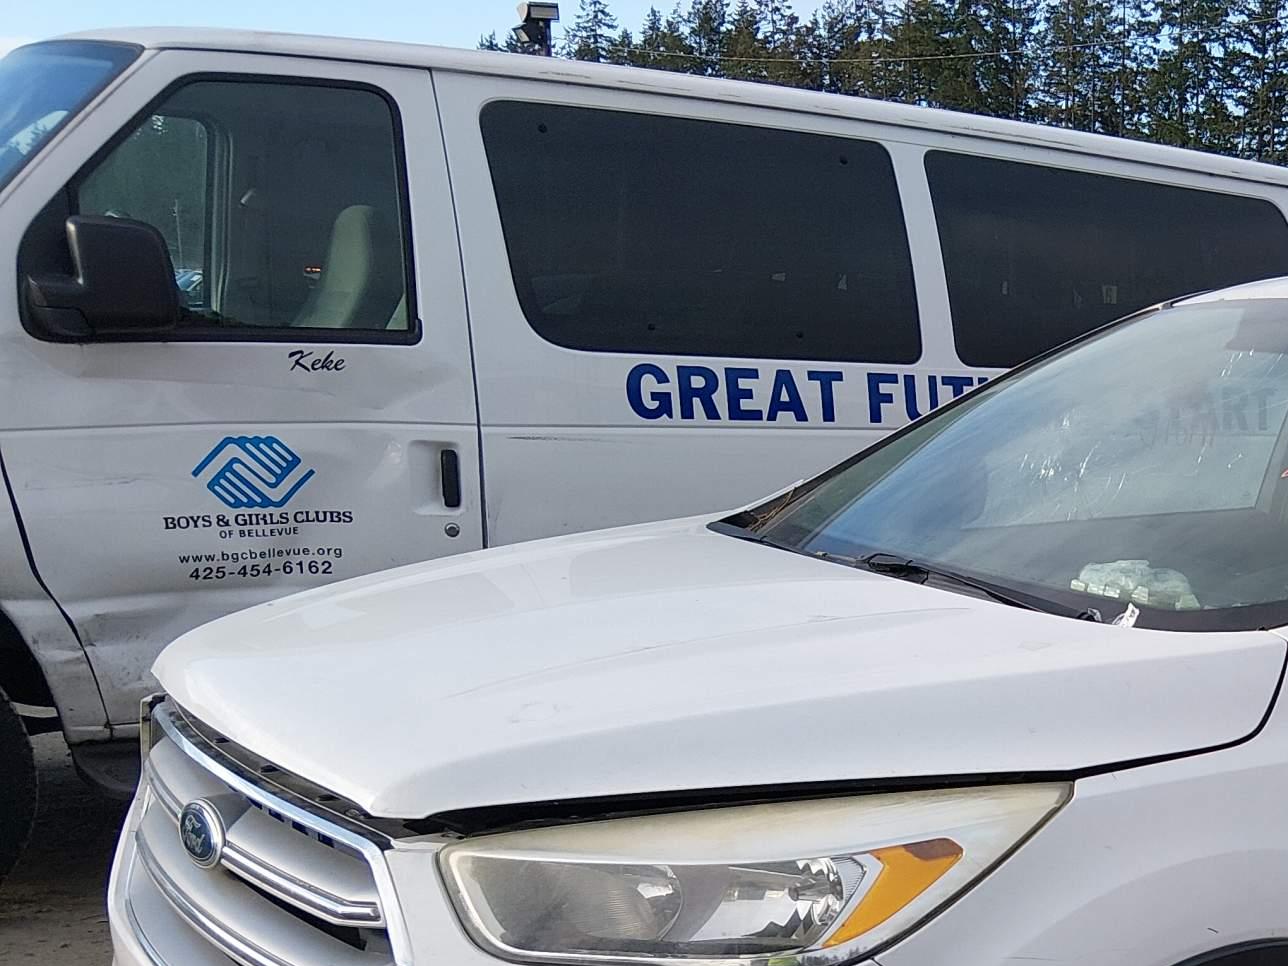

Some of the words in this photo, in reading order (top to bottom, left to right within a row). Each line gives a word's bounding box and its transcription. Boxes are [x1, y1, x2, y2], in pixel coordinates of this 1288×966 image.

[288, 350, 346, 372] Keke
[626, 363, 844, 423] GREAT
[866, 372, 989, 424] FUT
[163, 515, 212, 530] BOYS
[216, 513, 231, 528] &
[234, 512, 289, 527] GIRLS
[293, 510, 353, 525] CLUBS
[219, 530, 234, 539] OF
[239, 526, 299, 538] BELLEVUE
[179, 547, 342, 564] www.bgcbellevue.org
[189, 560, 333, 581] 425-454-6162
